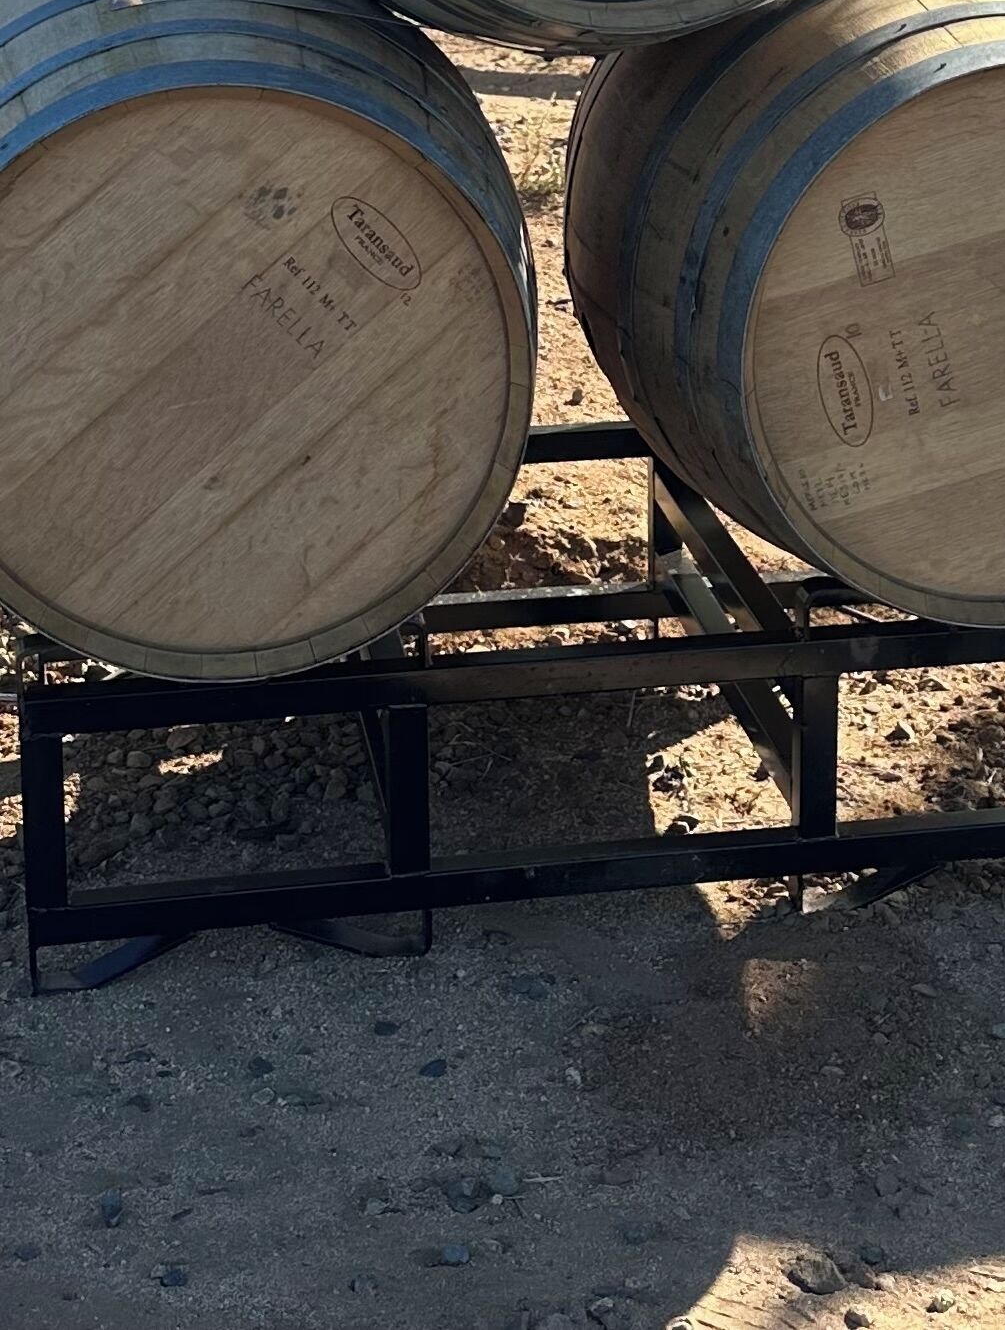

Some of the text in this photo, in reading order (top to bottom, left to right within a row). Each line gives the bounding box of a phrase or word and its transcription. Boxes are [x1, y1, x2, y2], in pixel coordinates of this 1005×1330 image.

[346, 204, 415, 278] Taransaud
[241, 272, 326, 360] FARELLA
[302, 276, 321, 296] 112
[824, 350, 858, 435] Taransaud
[900, 372, 916, 392] 112
[918, 311, 961, 408] FARELLA
